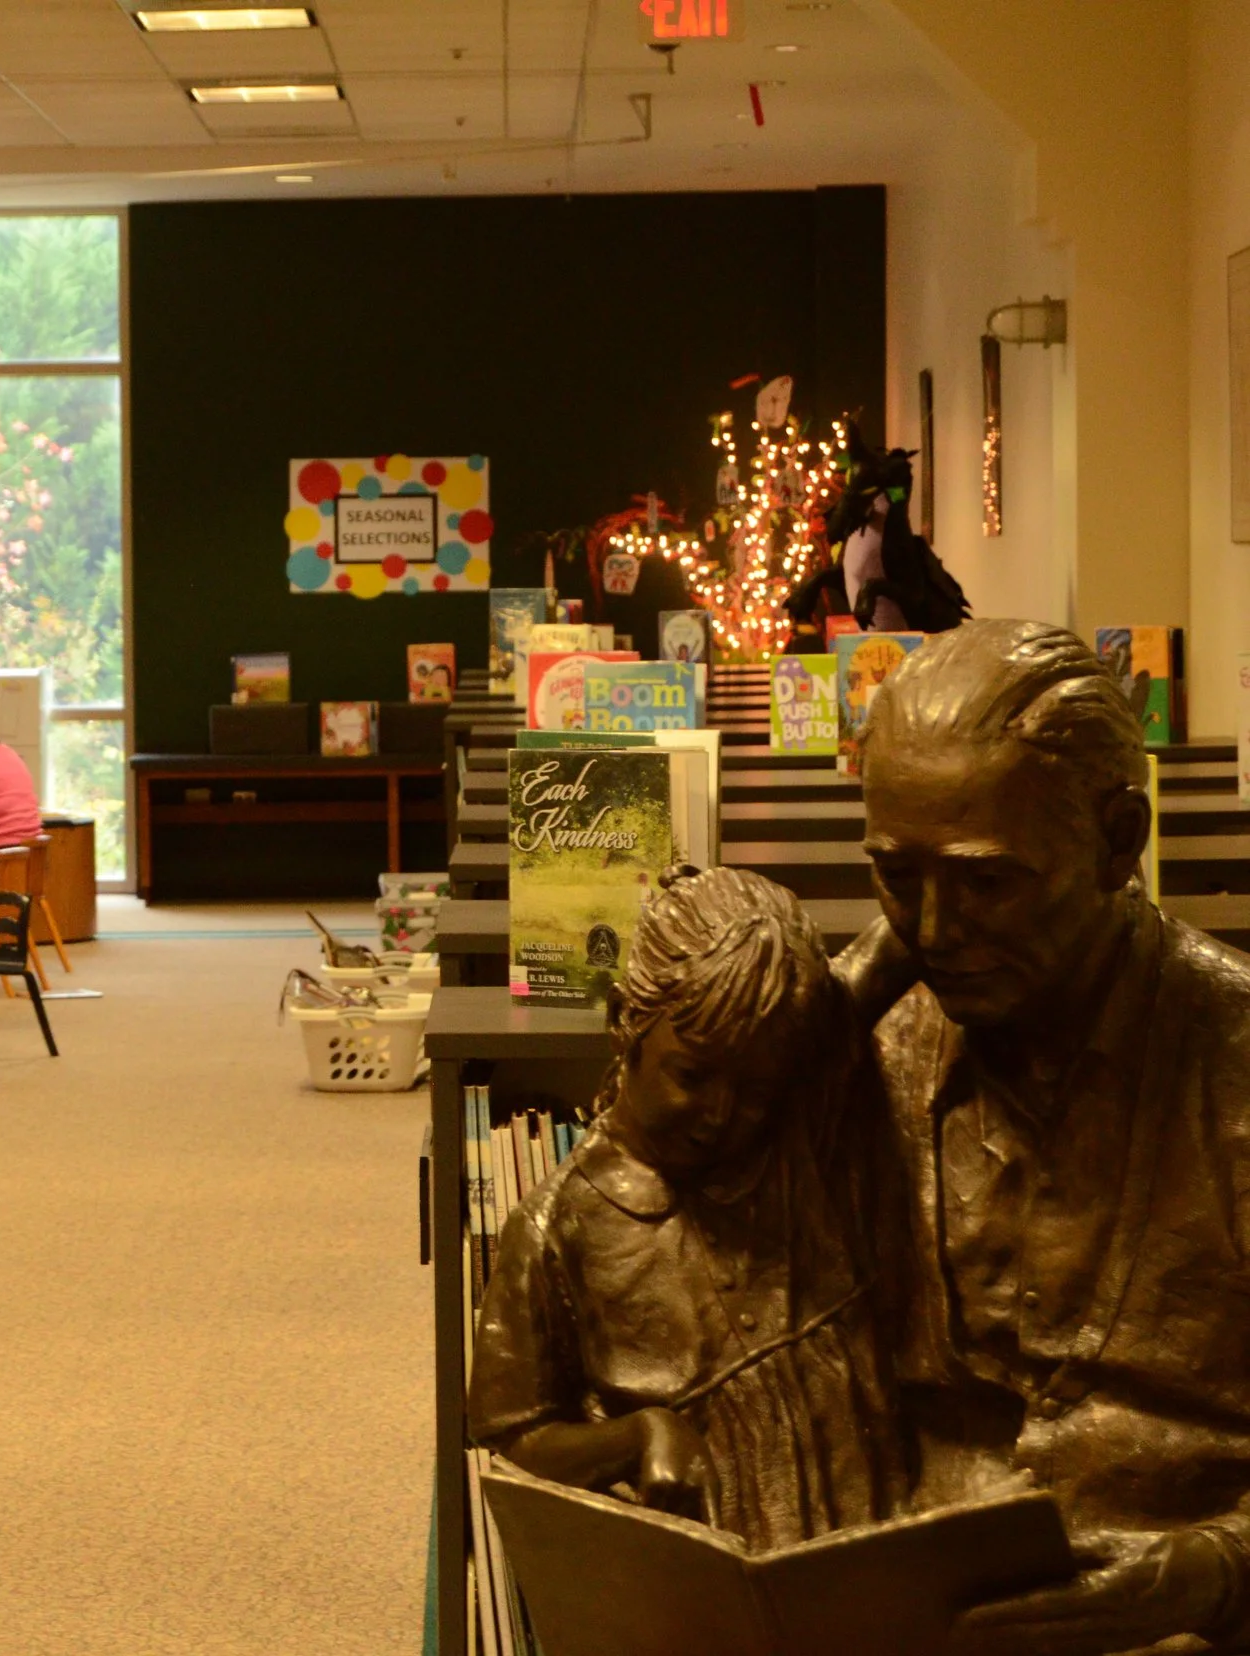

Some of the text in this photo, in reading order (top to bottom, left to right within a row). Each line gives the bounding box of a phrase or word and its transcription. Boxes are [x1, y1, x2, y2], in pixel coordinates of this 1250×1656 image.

[347, 509, 425, 523] SEASONAL
[342, 531, 431, 546] SELECTIONS
[586, 677, 687, 708] Boom
[586, 708, 687, 730] Boom
[778, 702, 823, 720] PUSH
[783, 720, 838, 741] BUTTO
[520, 759, 597, 806] Each
[514, 806, 638, 853] Kindness
[522, 942, 574, 951] JACQUELINE
[521, 953, 563, 961] WOODSON
[538, 975, 566, 984] LEWIS
